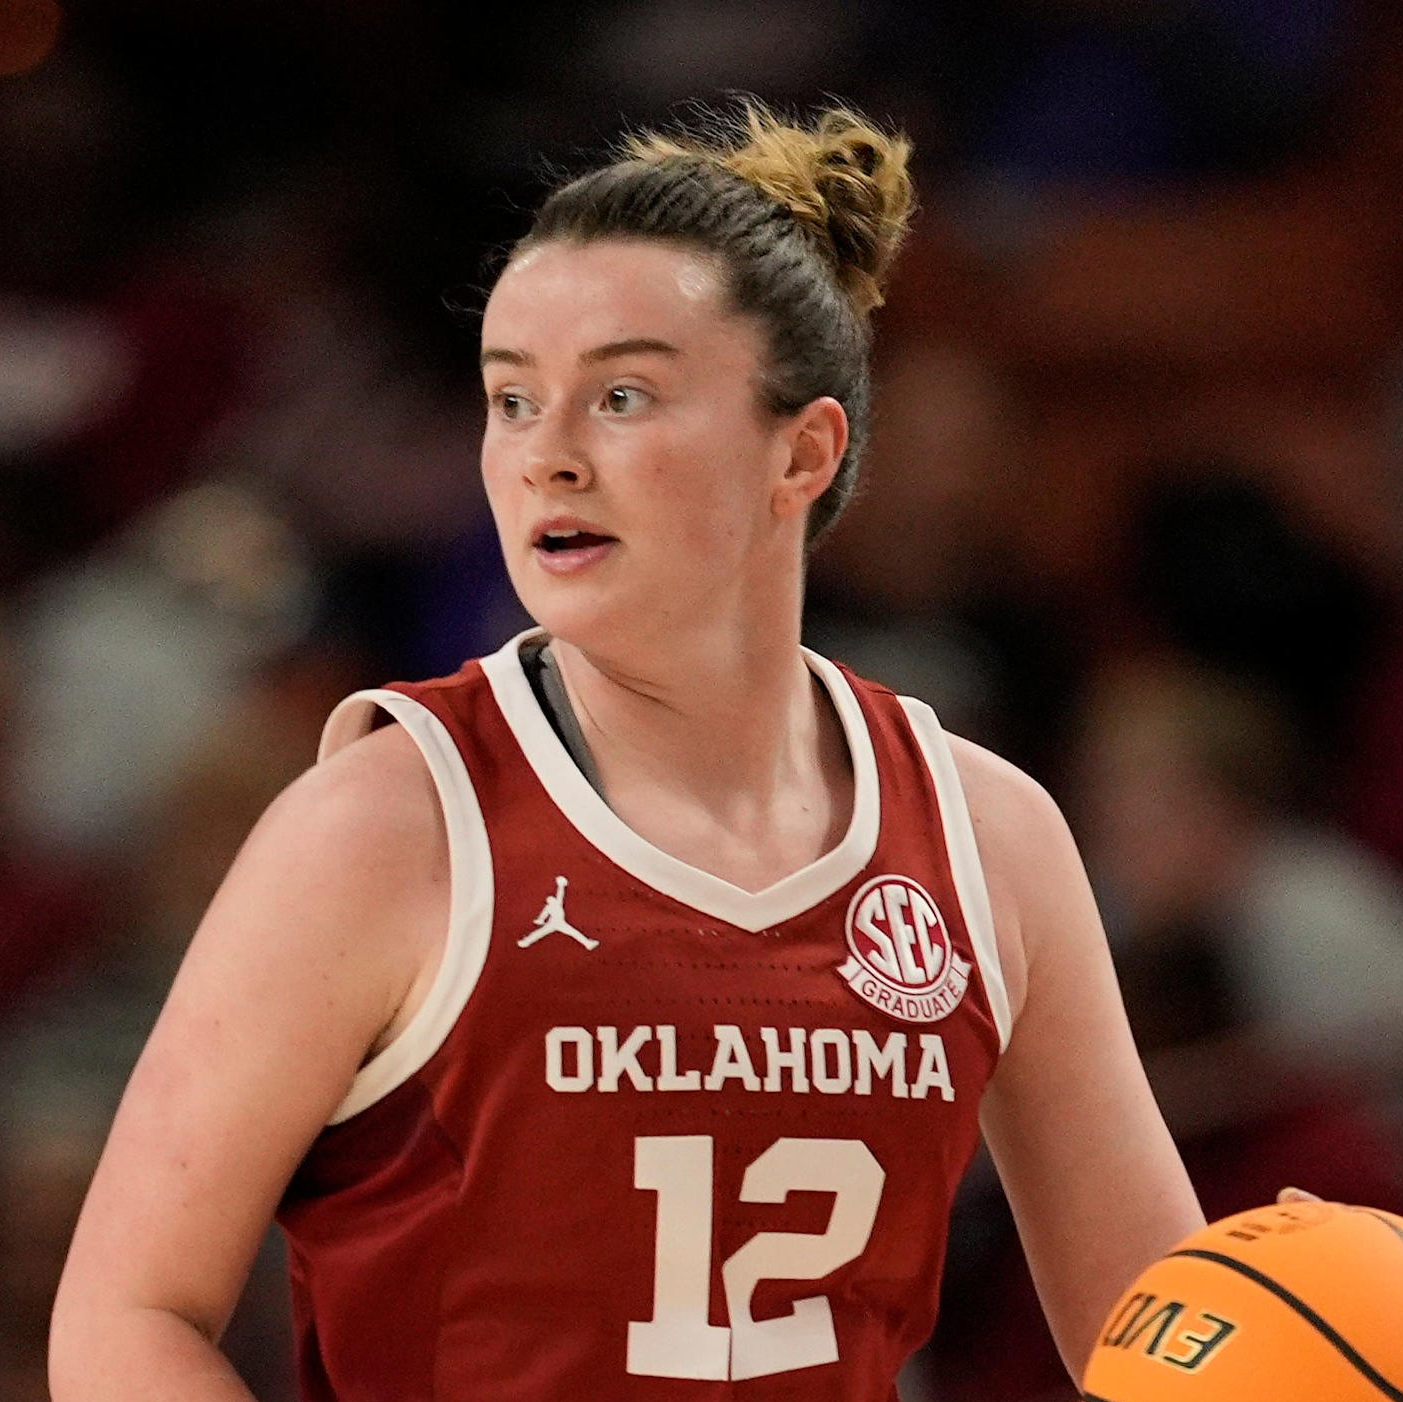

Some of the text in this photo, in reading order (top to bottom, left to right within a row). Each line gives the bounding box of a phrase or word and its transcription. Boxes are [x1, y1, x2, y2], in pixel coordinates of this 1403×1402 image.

[854, 883, 944, 985] SEC
[861, 979, 962, 1019] GRADUATE
[544, 1024, 956, 1102] OKLAHOMA
[626, 1134, 887, 1382] 12
